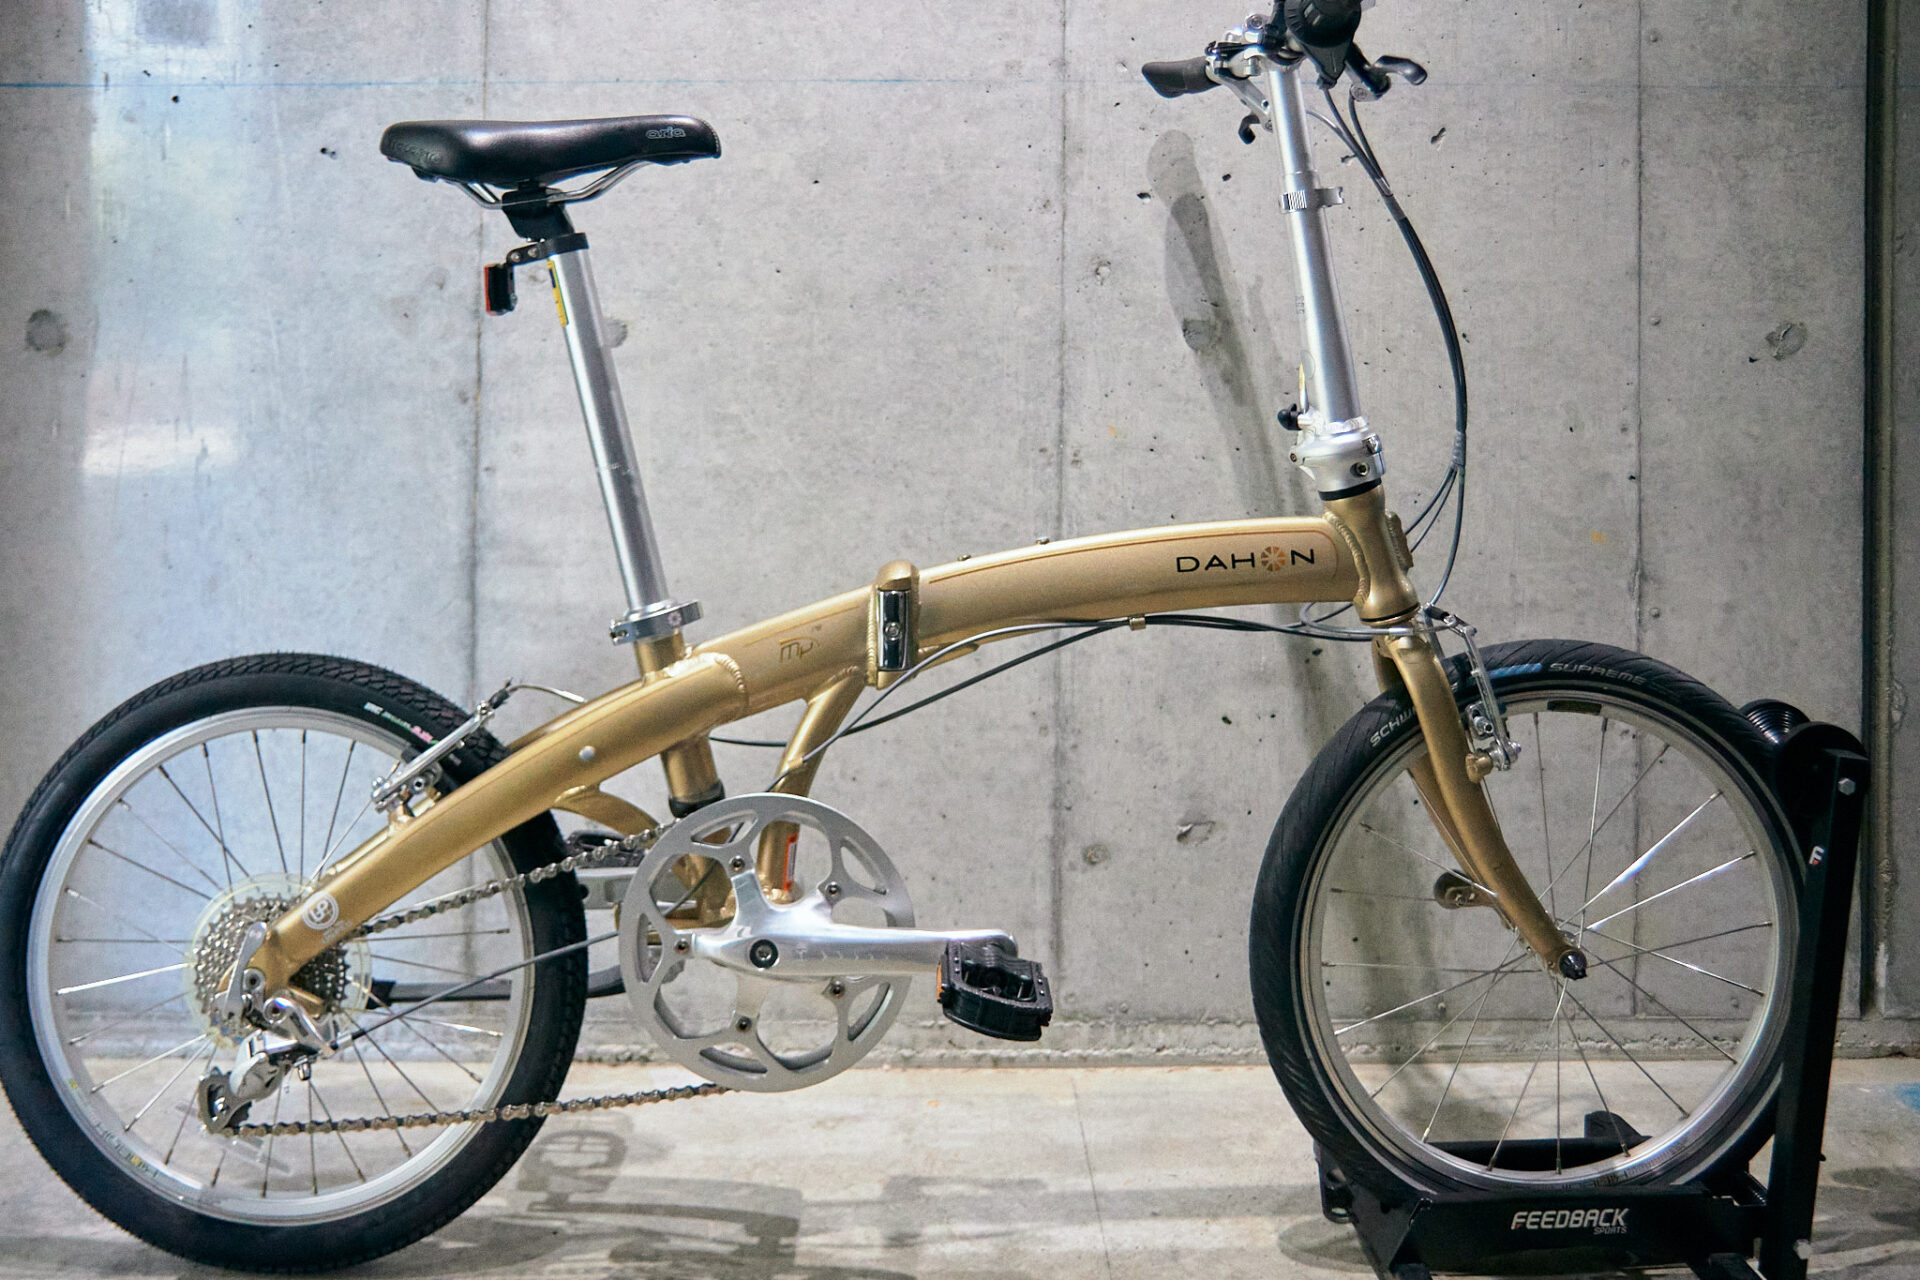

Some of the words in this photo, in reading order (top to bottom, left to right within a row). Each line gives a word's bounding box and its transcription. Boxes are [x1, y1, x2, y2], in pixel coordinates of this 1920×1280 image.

[1176, 545, 1315, 573] DAHON
[1550, 662, 1647, 685] SUPREME
[1511, 1208, 1629, 1230] FEEDBACK
[1593, 1226, 1627, 1235] SPORTS
